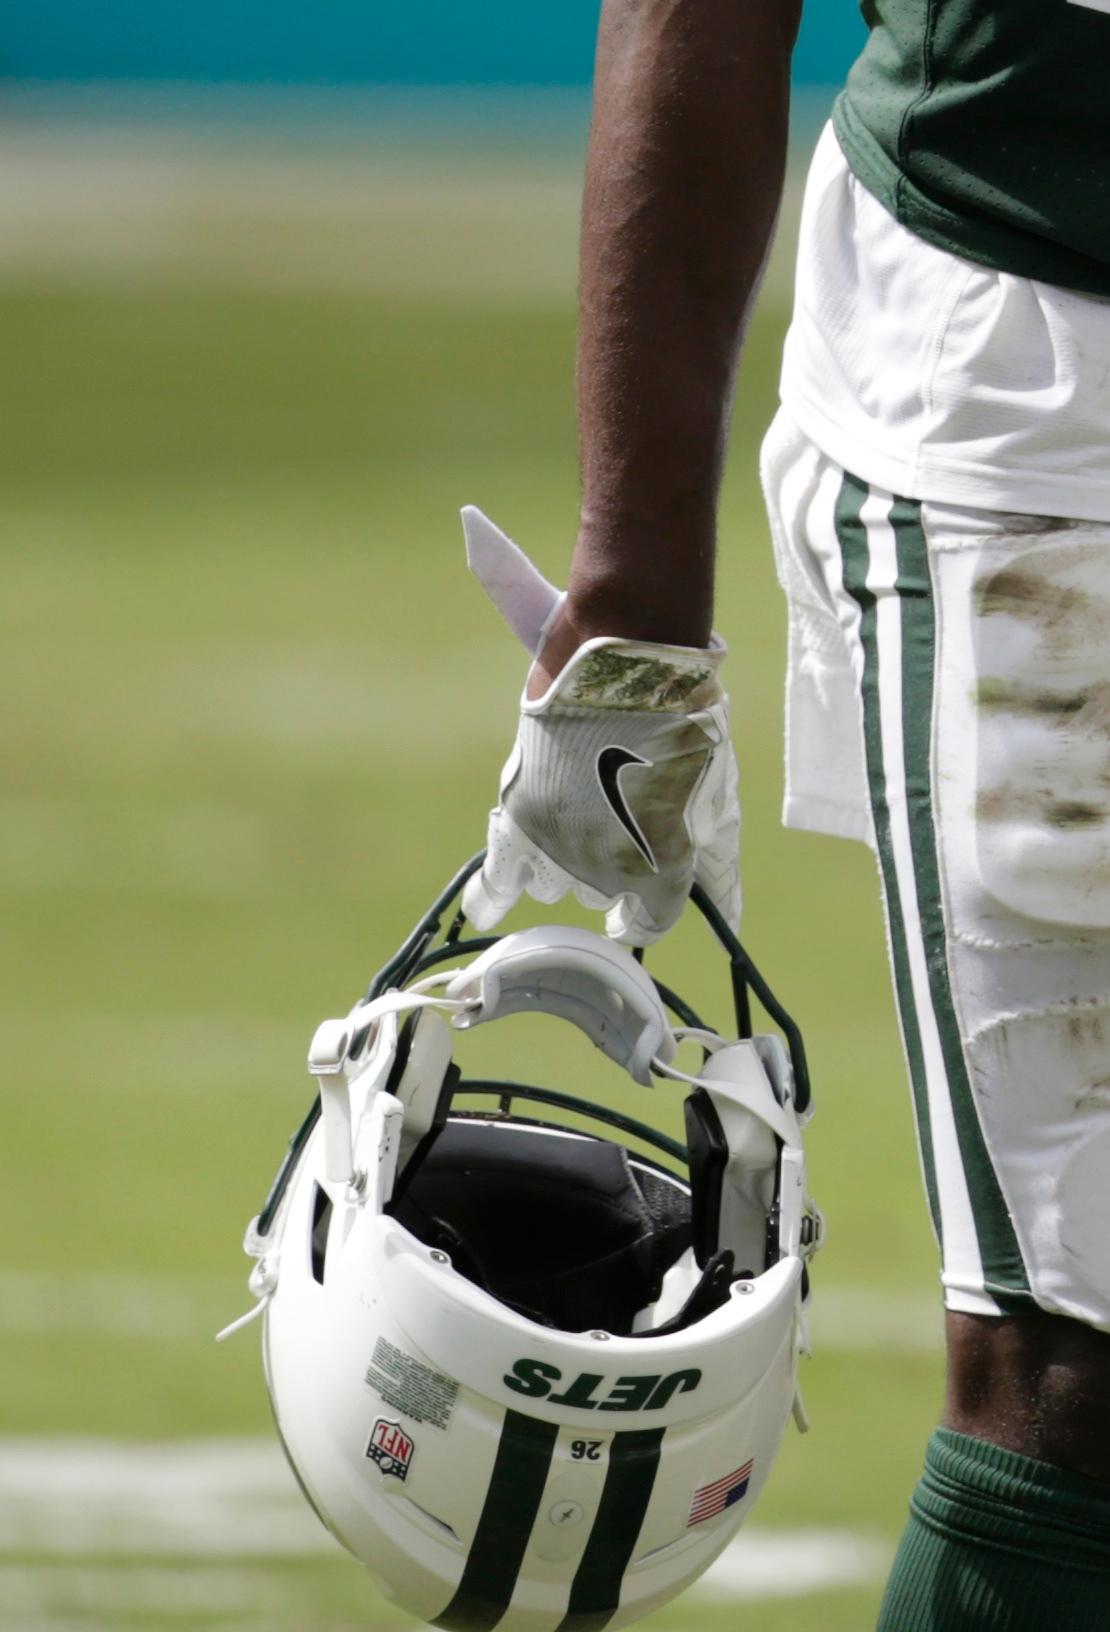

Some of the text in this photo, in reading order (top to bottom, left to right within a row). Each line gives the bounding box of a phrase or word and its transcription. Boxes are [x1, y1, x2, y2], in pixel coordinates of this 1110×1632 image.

[503, 1358, 703, 1411] JETS
[378, 1423, 411, 1463] NFL
[571, 1439, 605, 1460] 26
